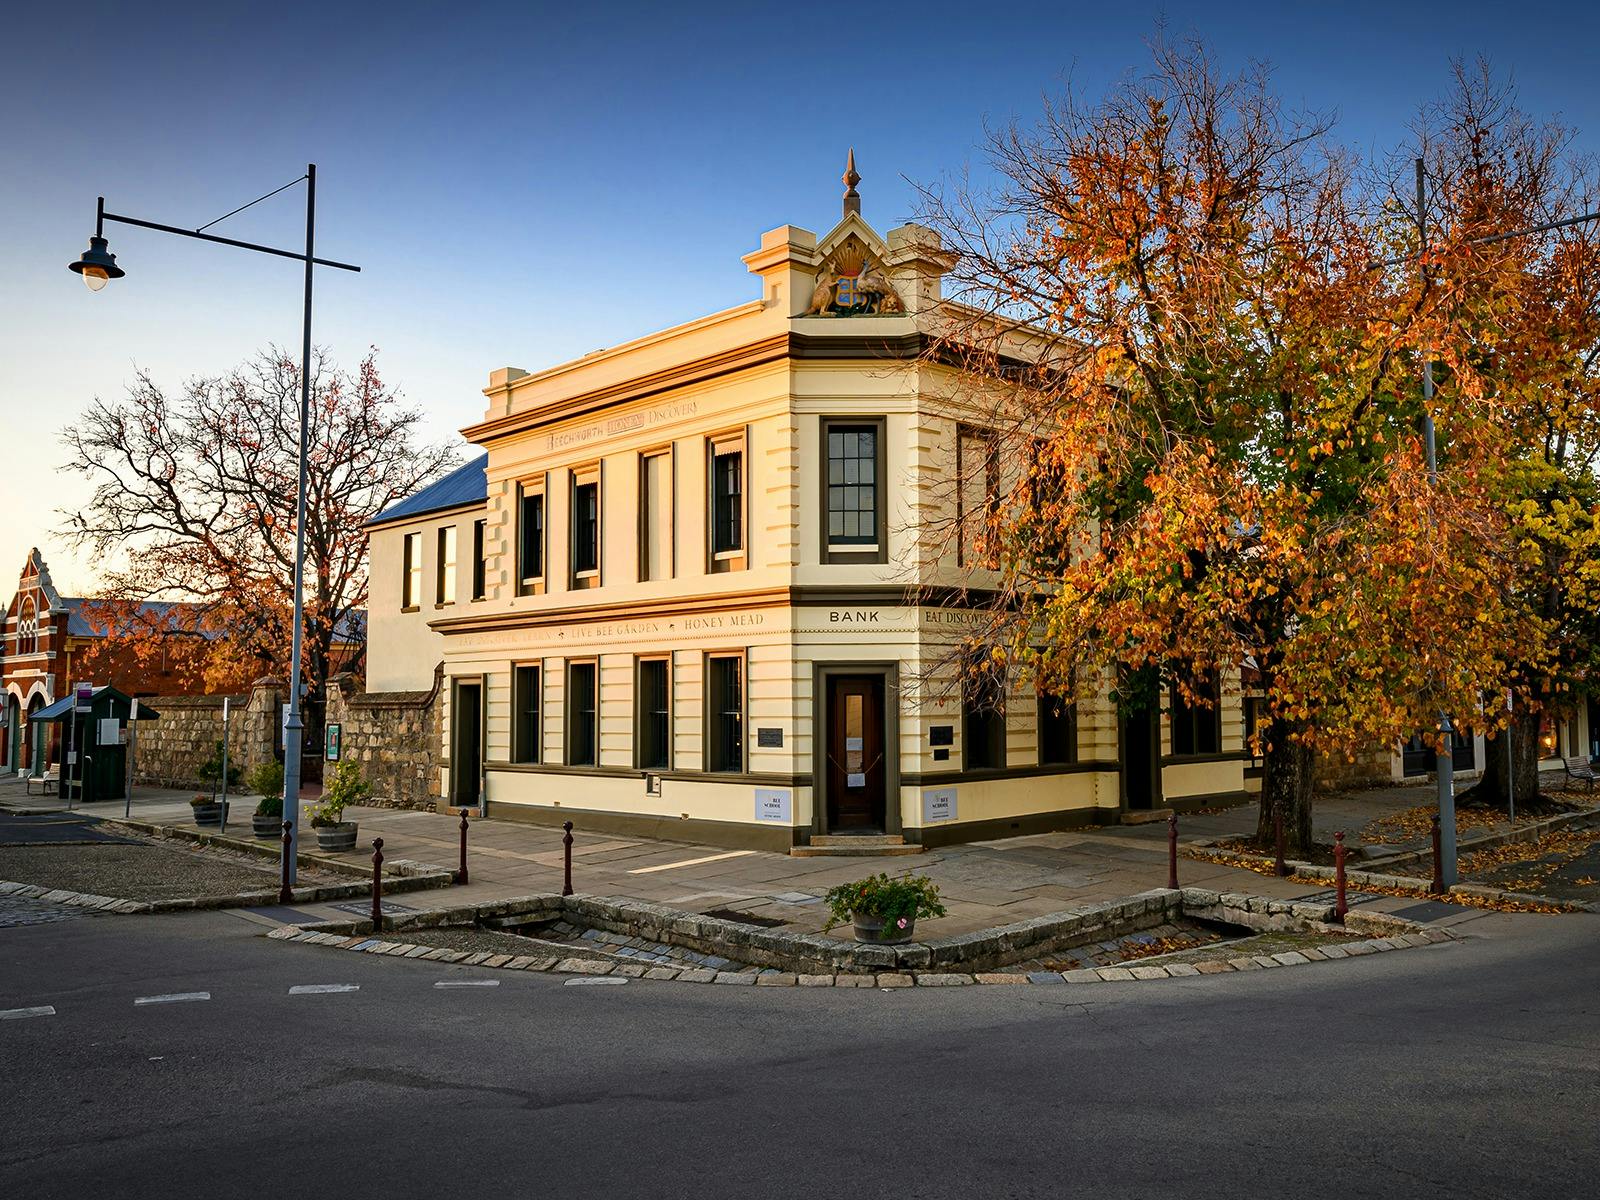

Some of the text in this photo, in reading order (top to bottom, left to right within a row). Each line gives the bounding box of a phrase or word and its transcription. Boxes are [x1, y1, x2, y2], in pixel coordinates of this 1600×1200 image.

[830, 611, 879, 622] BANK
[925, 611, 943, 623] EAT
[571, 613, 764, 639] LIVE BEE GARDEN HONEY MEAD
